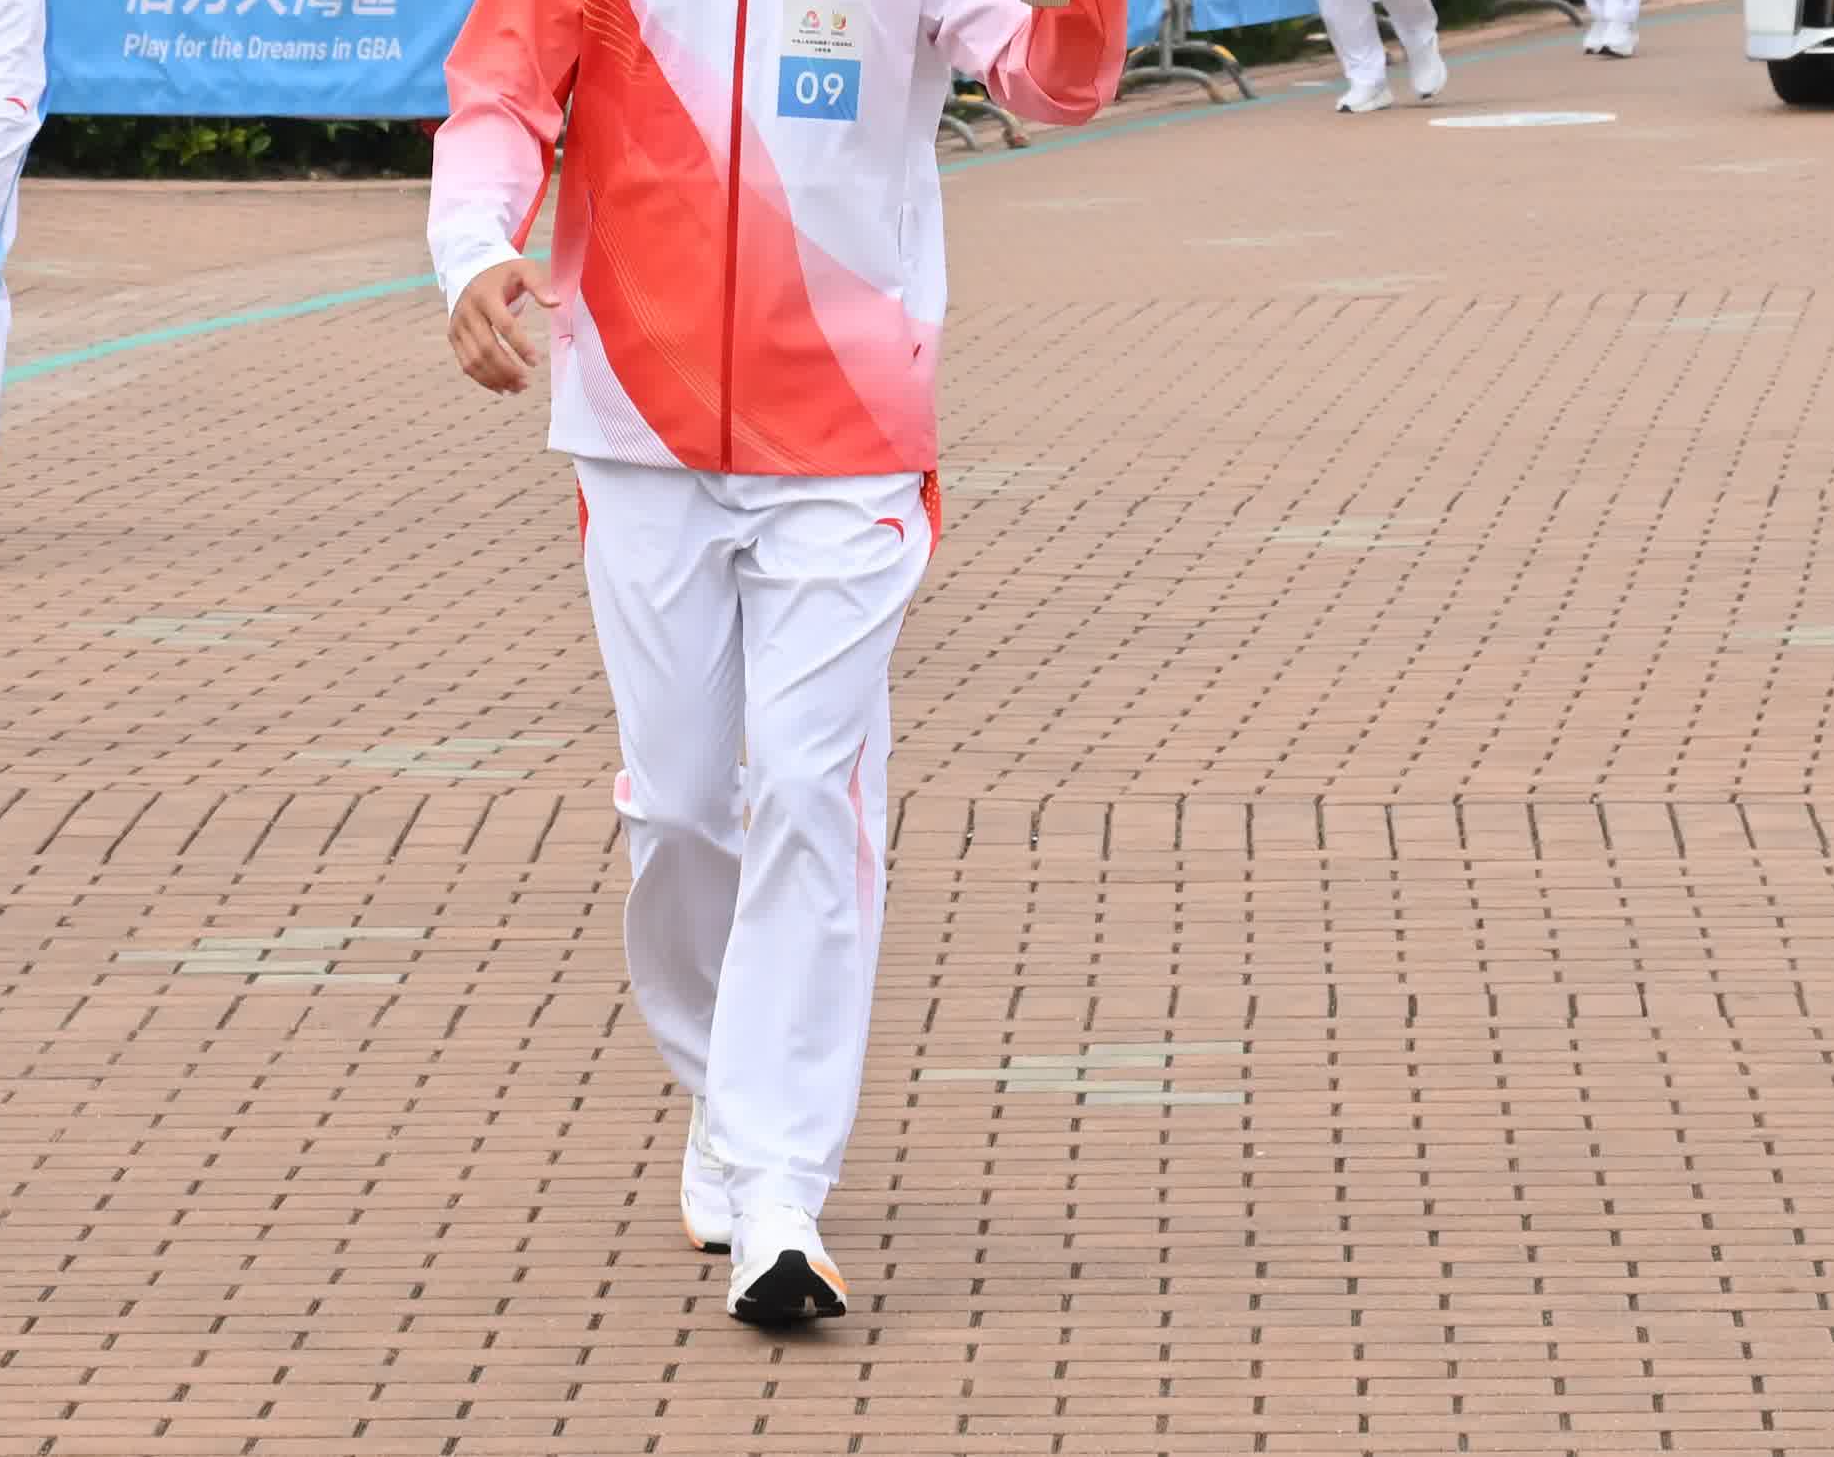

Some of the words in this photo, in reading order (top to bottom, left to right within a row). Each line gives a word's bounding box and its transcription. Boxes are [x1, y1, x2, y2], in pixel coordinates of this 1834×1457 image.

[122, 32, 168, 63] Play
[174, 33, 207, 60] for
[211, 34, 244, 60] the
[246, 34, 329, 62] Dreams
[332, 37, 352, 61] in
[356, 36, 404, 61] GBA
[795, 70, 845, 106] 09
